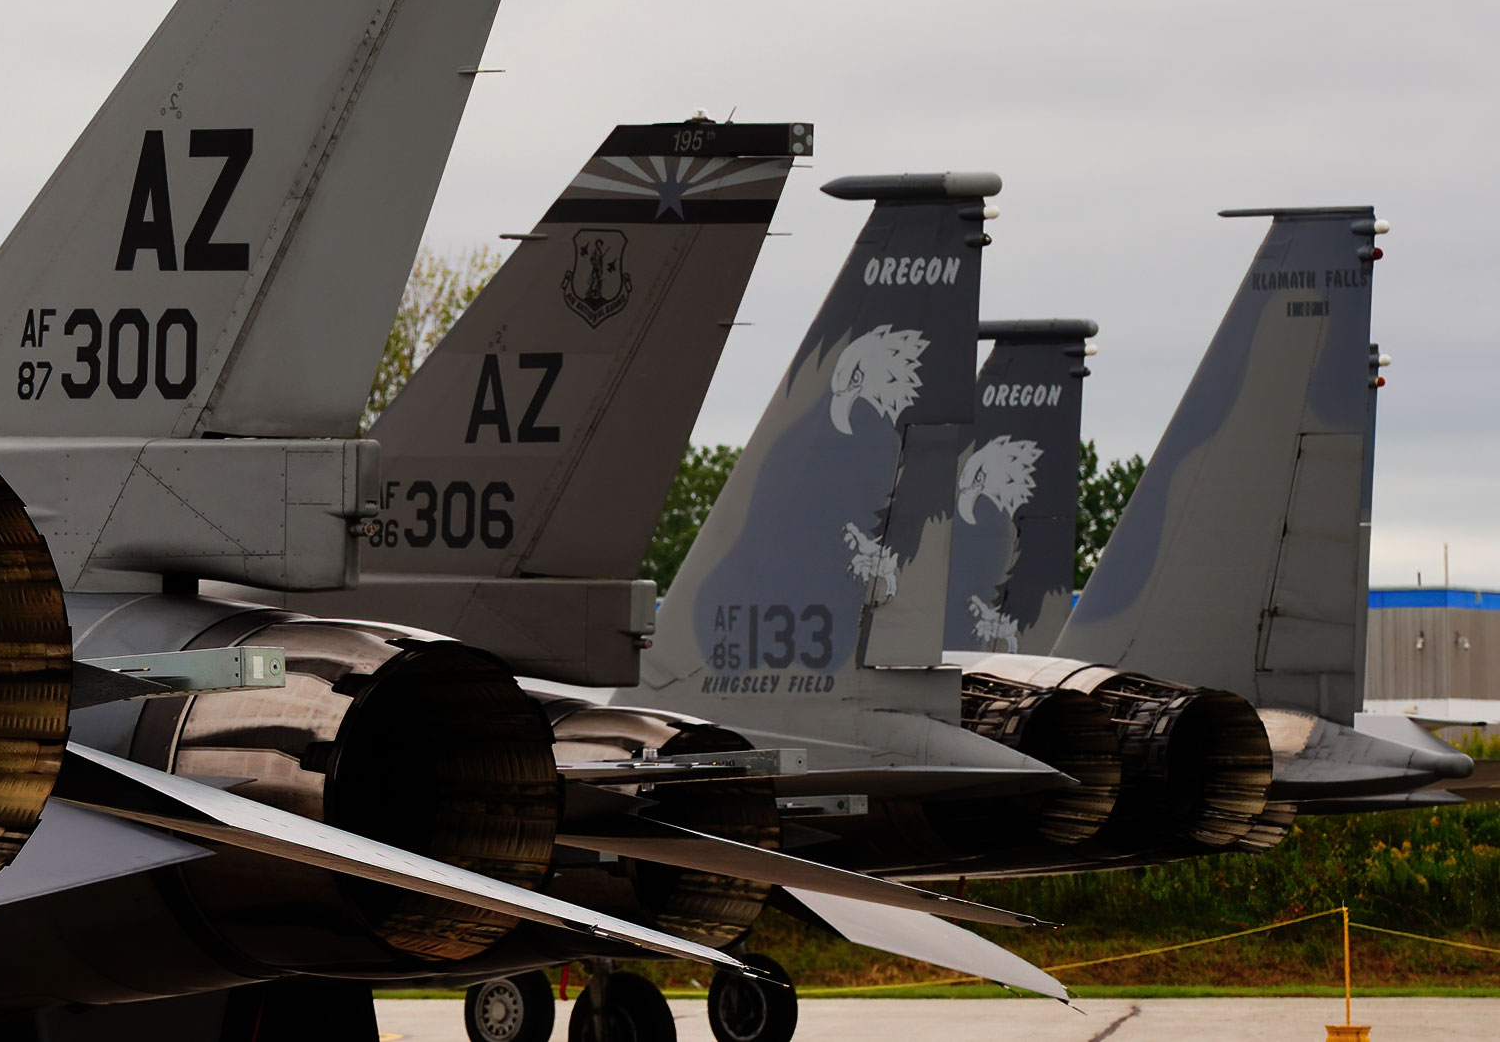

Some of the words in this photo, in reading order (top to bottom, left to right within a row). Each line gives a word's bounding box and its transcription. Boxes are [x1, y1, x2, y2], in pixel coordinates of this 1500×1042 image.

[115, 128, 254, 271] AZ
[864, 257, 960, 287] OREGON
[1252, 270, 1316, 291] KLAMATH
[1325, 269, 1368, 289] FALLS
[20, 309, 57, 347] AF
[61, 308, 198, 399] 300
[17, 361, 53, 400] 87
[464, 352, 564, 444] AZ
[982, 384, 1062, 407] OREGON
[404, 481, 515, 549] 306
[713, 605, 742, 632] AF
[748, 604, 834, 670] 133
[713, 643, 741, 670] 85
[701, 675, 780, 694] KINGSLEY
[788, 675, 835, 693] FIELD
